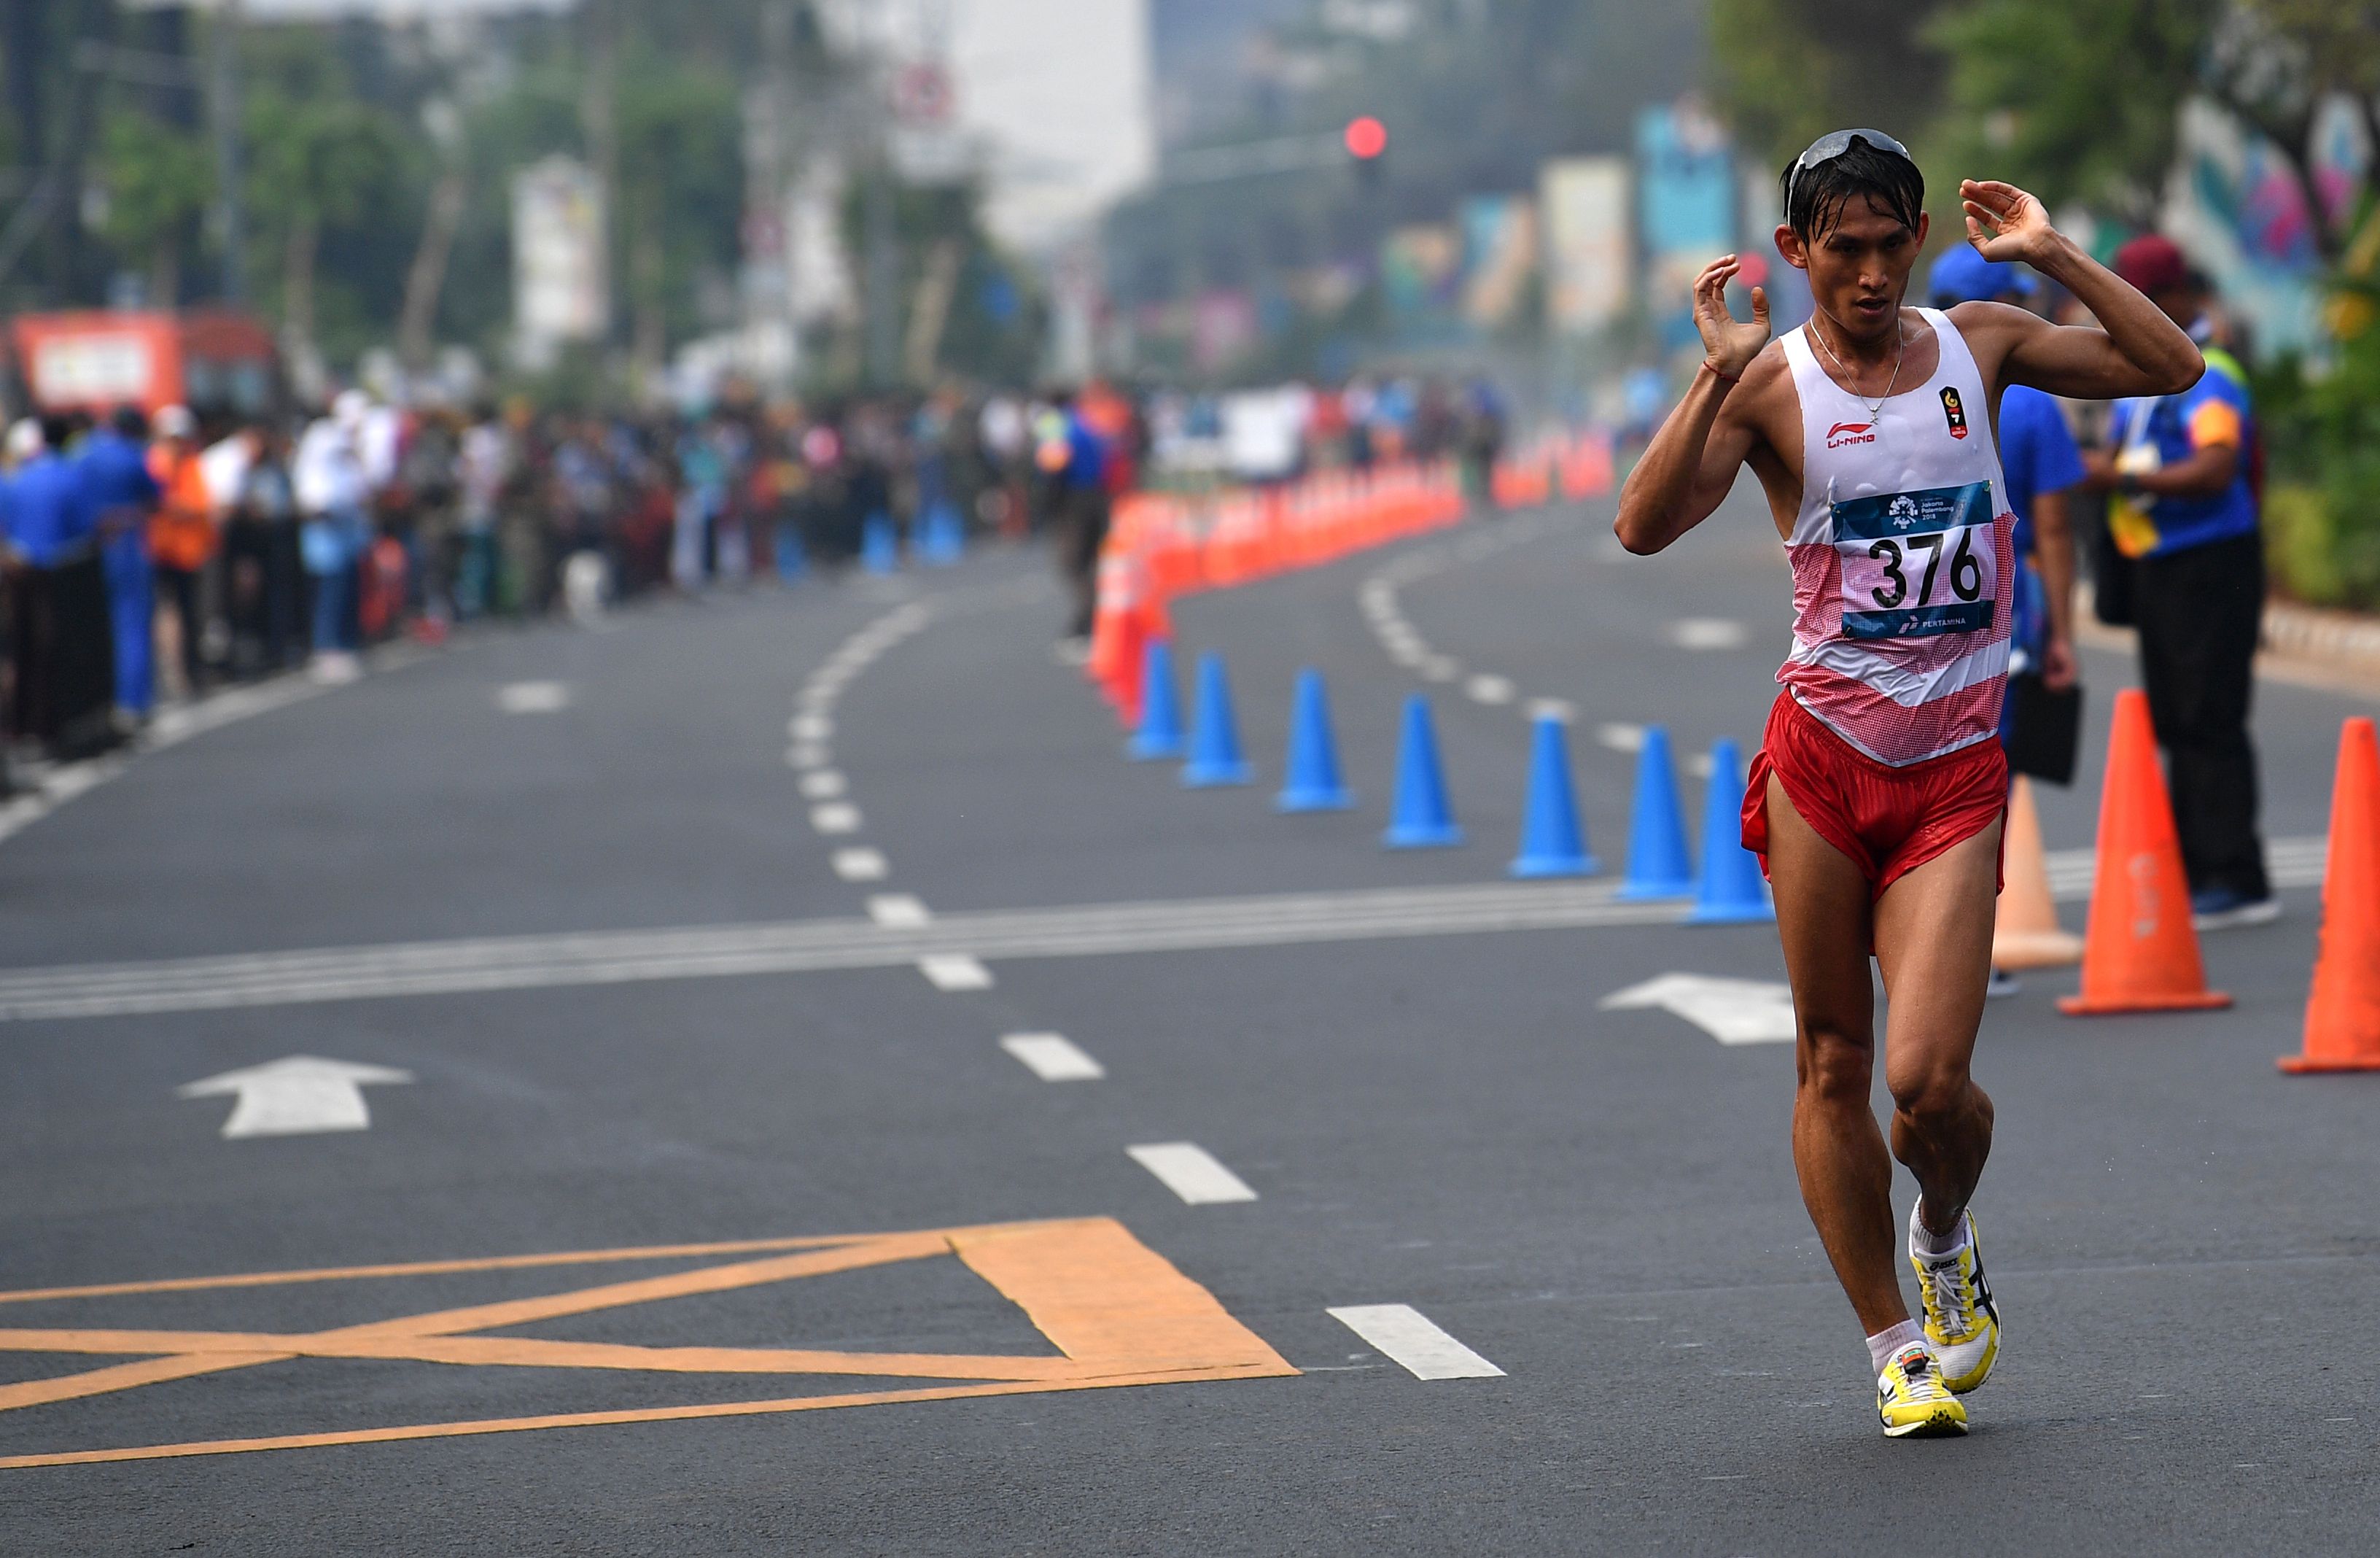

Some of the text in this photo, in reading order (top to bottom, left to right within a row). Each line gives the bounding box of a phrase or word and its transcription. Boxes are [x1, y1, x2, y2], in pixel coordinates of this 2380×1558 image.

[1827, 434, 1875, 449] LI-NING
[1922, 513, 1937, 521] 2018
[1869, 527, 1981, 608] 376
[1922, 617, 1967, 628] PERTAMINA
